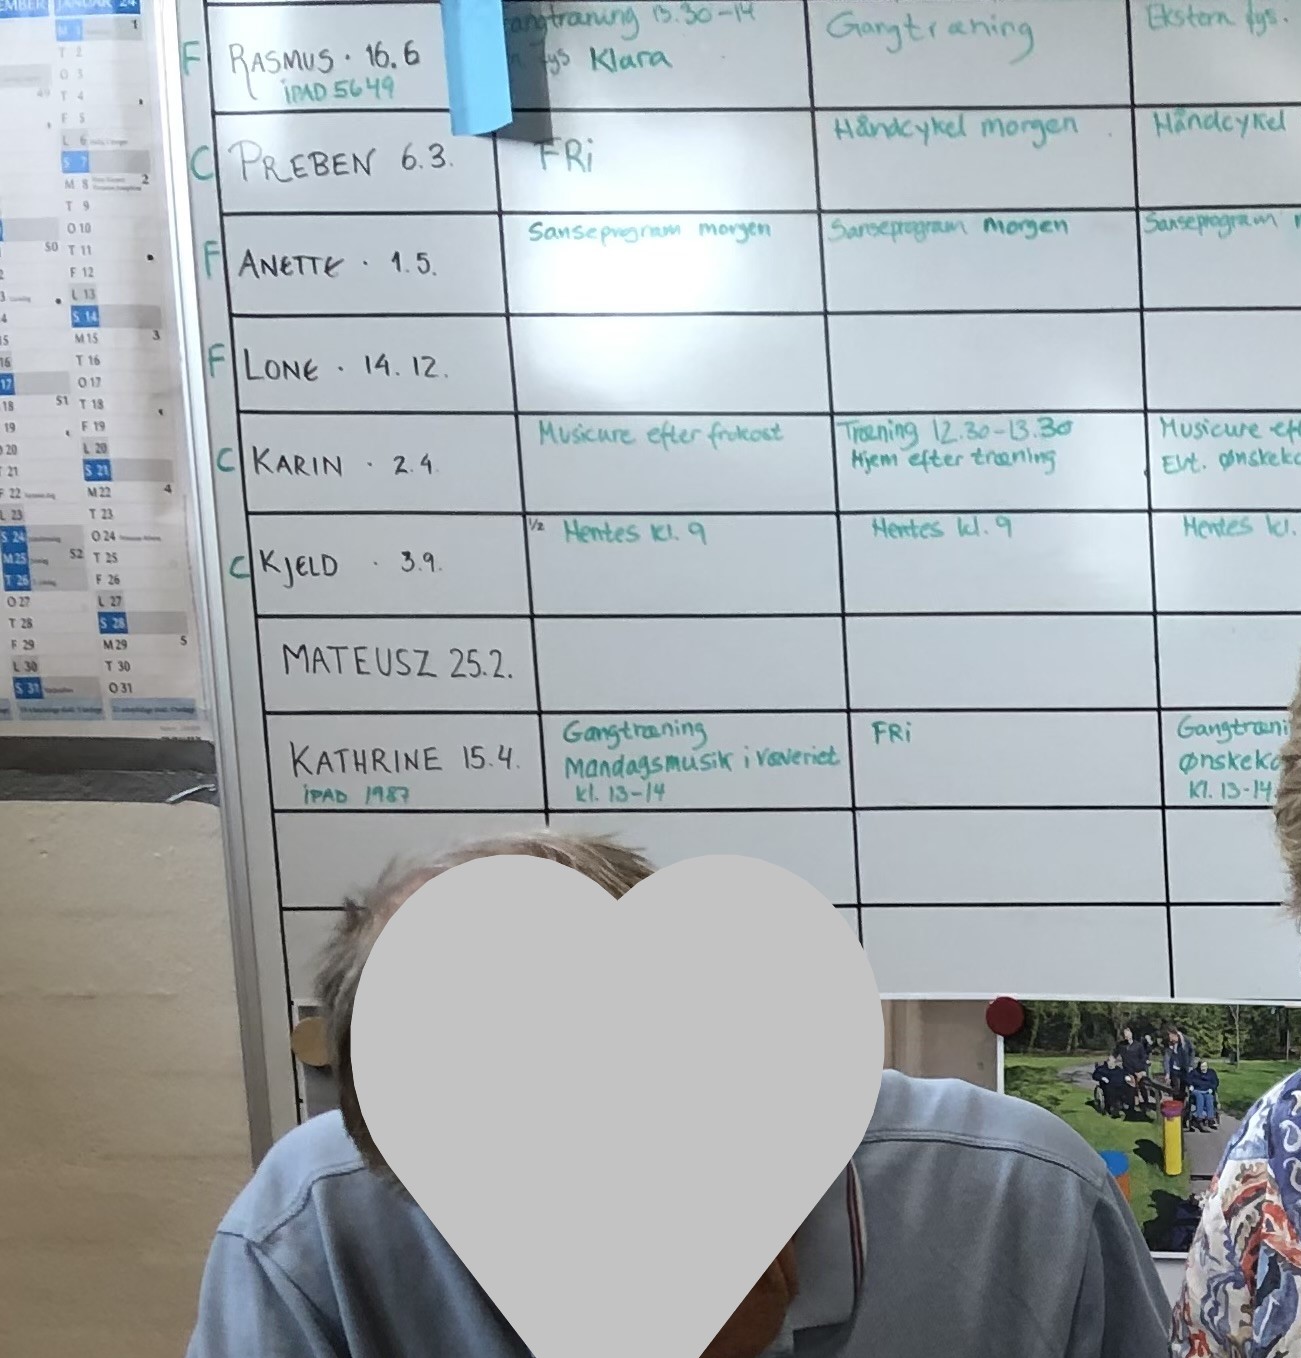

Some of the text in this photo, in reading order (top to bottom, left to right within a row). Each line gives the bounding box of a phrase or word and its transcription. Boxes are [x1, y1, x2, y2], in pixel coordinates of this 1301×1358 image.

[826, 10, 1034, 65] Gangtræning
[181, 40, 200, 75] F
[229, 43, 335, 100] RASMUS
[590, 47, 673, 74] Klara
[333, 76, 396, 100] 5649
[834, 113, 967, 146] Håndcykel
[1153, 107, 1287, 139] Håndcykel
[190, 145, 214, 180] C
[228, 140, 376, 183] PREBEN
[528, 220, 771, 247] Sanseprogram morgen
[828, 218, 968, 243] Sanseprogram
[1144, 211, 1278, 239] Sanseprogram
[203, 240, 221, 280] F
[237, 248, 344, 279] ANETTE
[207, 343, 226, 378] F
[243, 349, 319, 381] LONE
[646, 420, 702, 452] efter
[708, 420, 784, 450] frokost
[837, 418, 919, 451] Træning
[216, 447, 236, 473] C
[252, 445, 343, 477] KARIN
[851, 447, 1056, 476] Hjem efter træning
[563, 518, 707, 545] Hentes 9
[872, 516, 945, 539] Hentes
[996, 515, 1012, 538] 9
[1183, 515, 1253, 539] Hentes
[229, 556, 251, 579] C
[103, 639, 127, 650] M 29
[104, 660, 131, 672] T 30
[282, 643, 514, 680] MATEUSZ 25.2.
[108, 682, 133, 694] O 31
[562, 719, 708, 750] Gangtræning
[1177, 714, 1289, 745] Gangtræni
[289, 741, 443, 778] KATHRINE
[565, 750, 734, 781] Mandagsmusik
[1179, 749, 1280, 775] Ønskeko
[609, 782, 665, 803] 13-14
